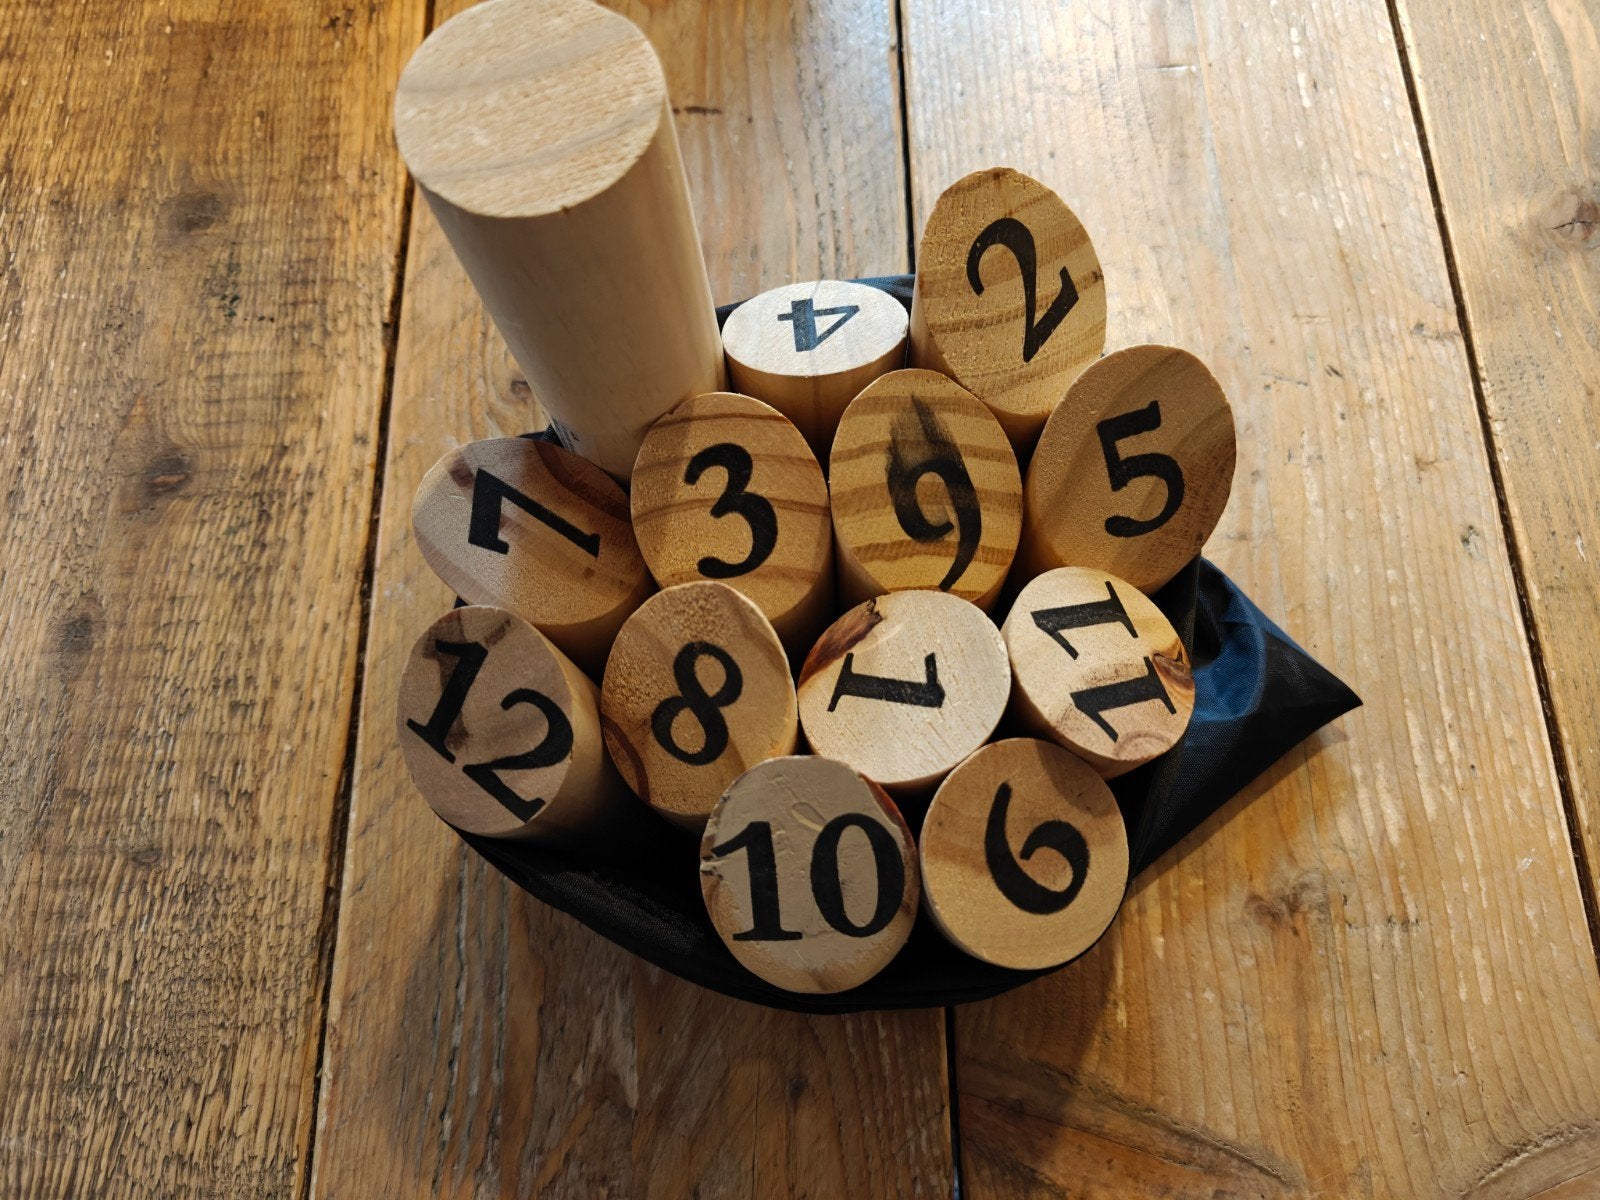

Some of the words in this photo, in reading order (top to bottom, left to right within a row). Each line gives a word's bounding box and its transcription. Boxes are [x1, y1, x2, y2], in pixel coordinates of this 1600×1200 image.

[777, 298, 860, 352] 4
[966, 217, 1079, 363] 2
[468, 467, 600, 558] 7
[684, 442, 778, 579] 3
[1096, 400, 1185, 538] 5
[650, 640, 744, 766] 8
[827, 651, 946, 713] 1
[1030, 580, 1177, 743] 11
[406, 638, 574, 824] 12
[710, 811, 905, 942] 10
[984, 780, 1091, 915] 6
